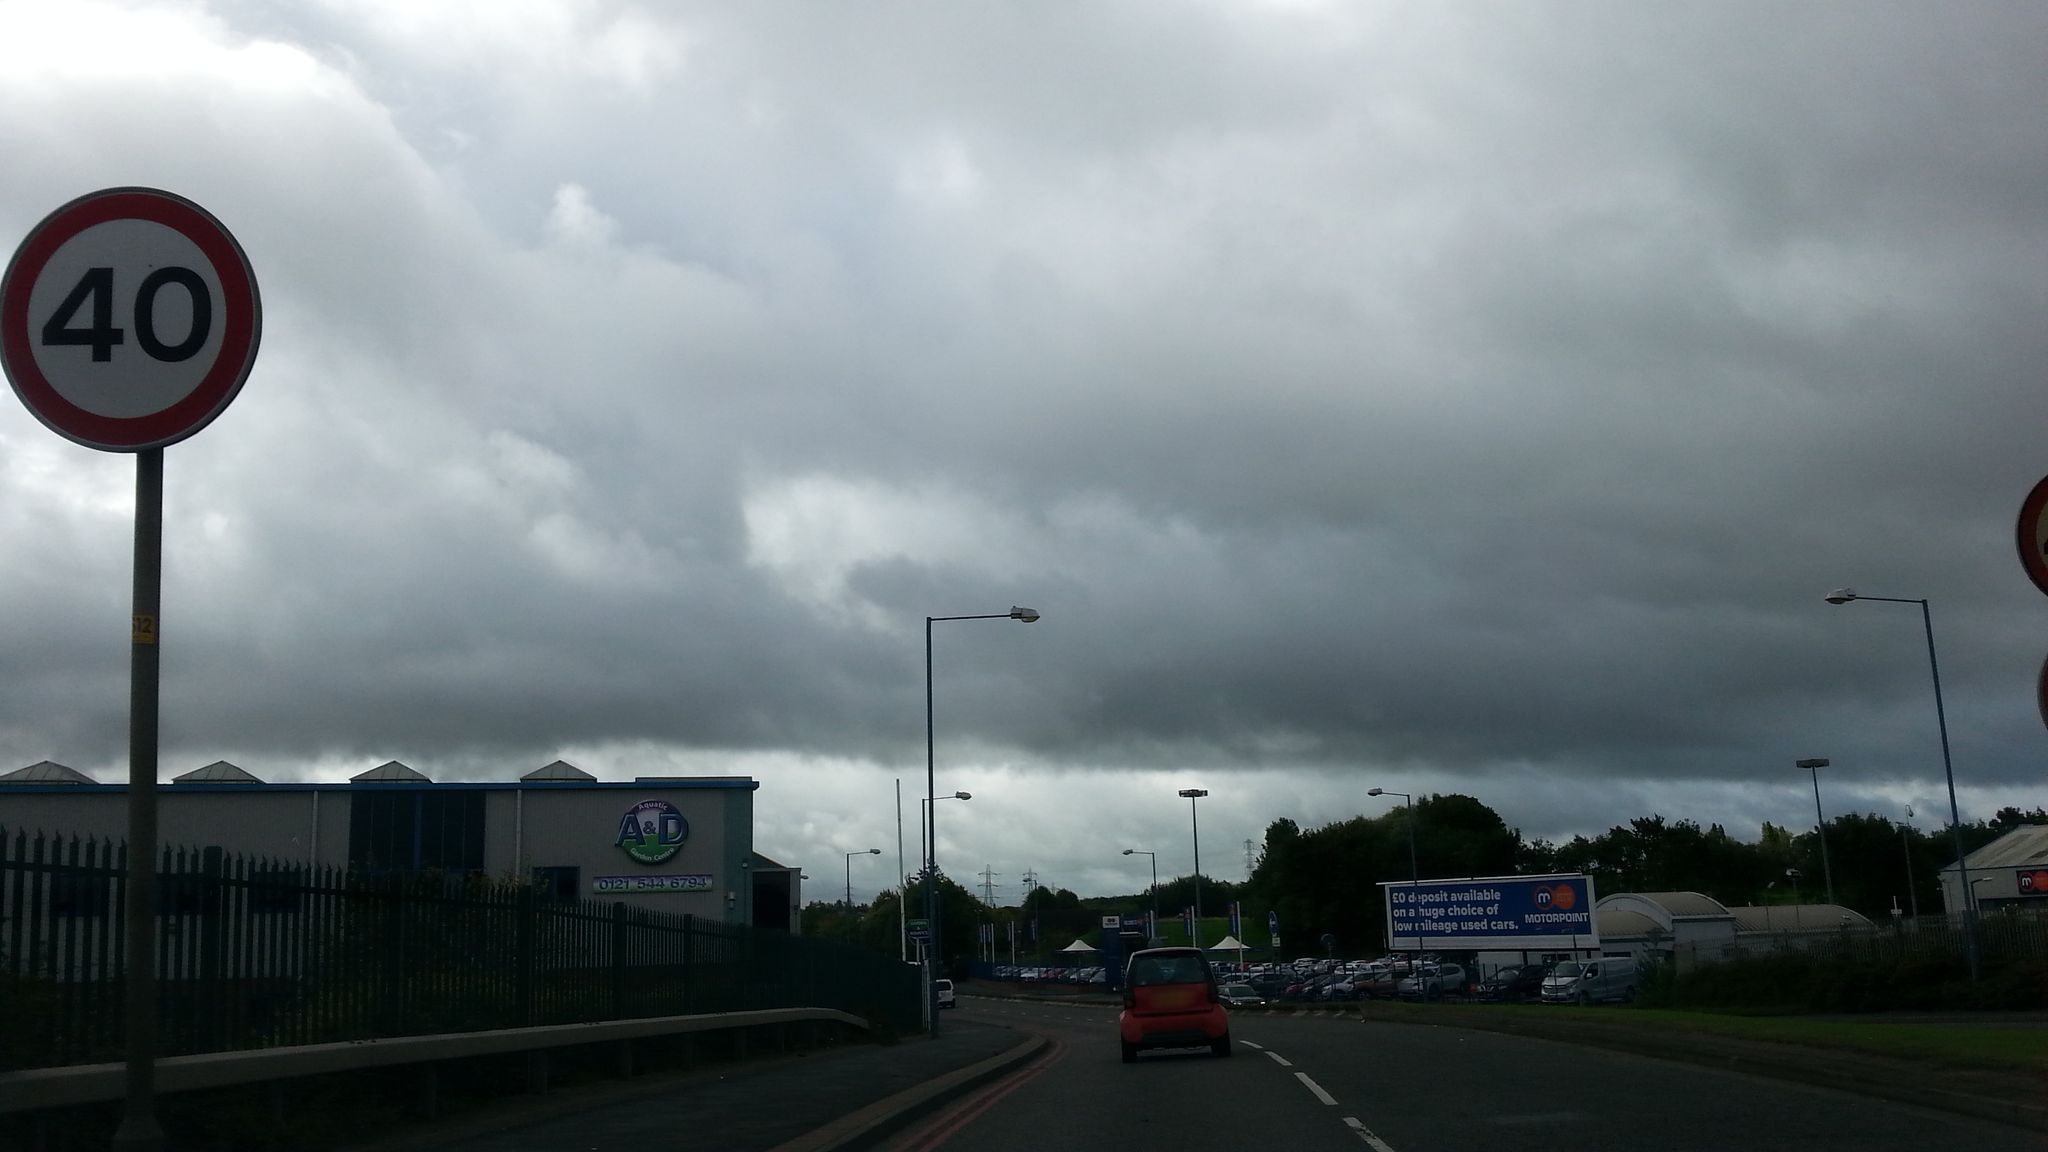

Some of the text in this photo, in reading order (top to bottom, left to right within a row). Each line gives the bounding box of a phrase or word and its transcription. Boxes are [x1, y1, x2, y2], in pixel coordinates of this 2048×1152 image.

[42, 266, 212, 363] 40
[638, 802, 668, 811] Aquatic
[630, 847, 653, 861] Garden
[599, 877, 707, 890] 0121 544 6794
[1392, 892, 1406, 903] £0
[1450, 889, 1501, 901] available
[1393, 903, 1499, 919] on a huge choice of
[1524, 912, 1589, 924] MOTORPOINT
[1394, 918, 1518, 933] low mileage used cars.
